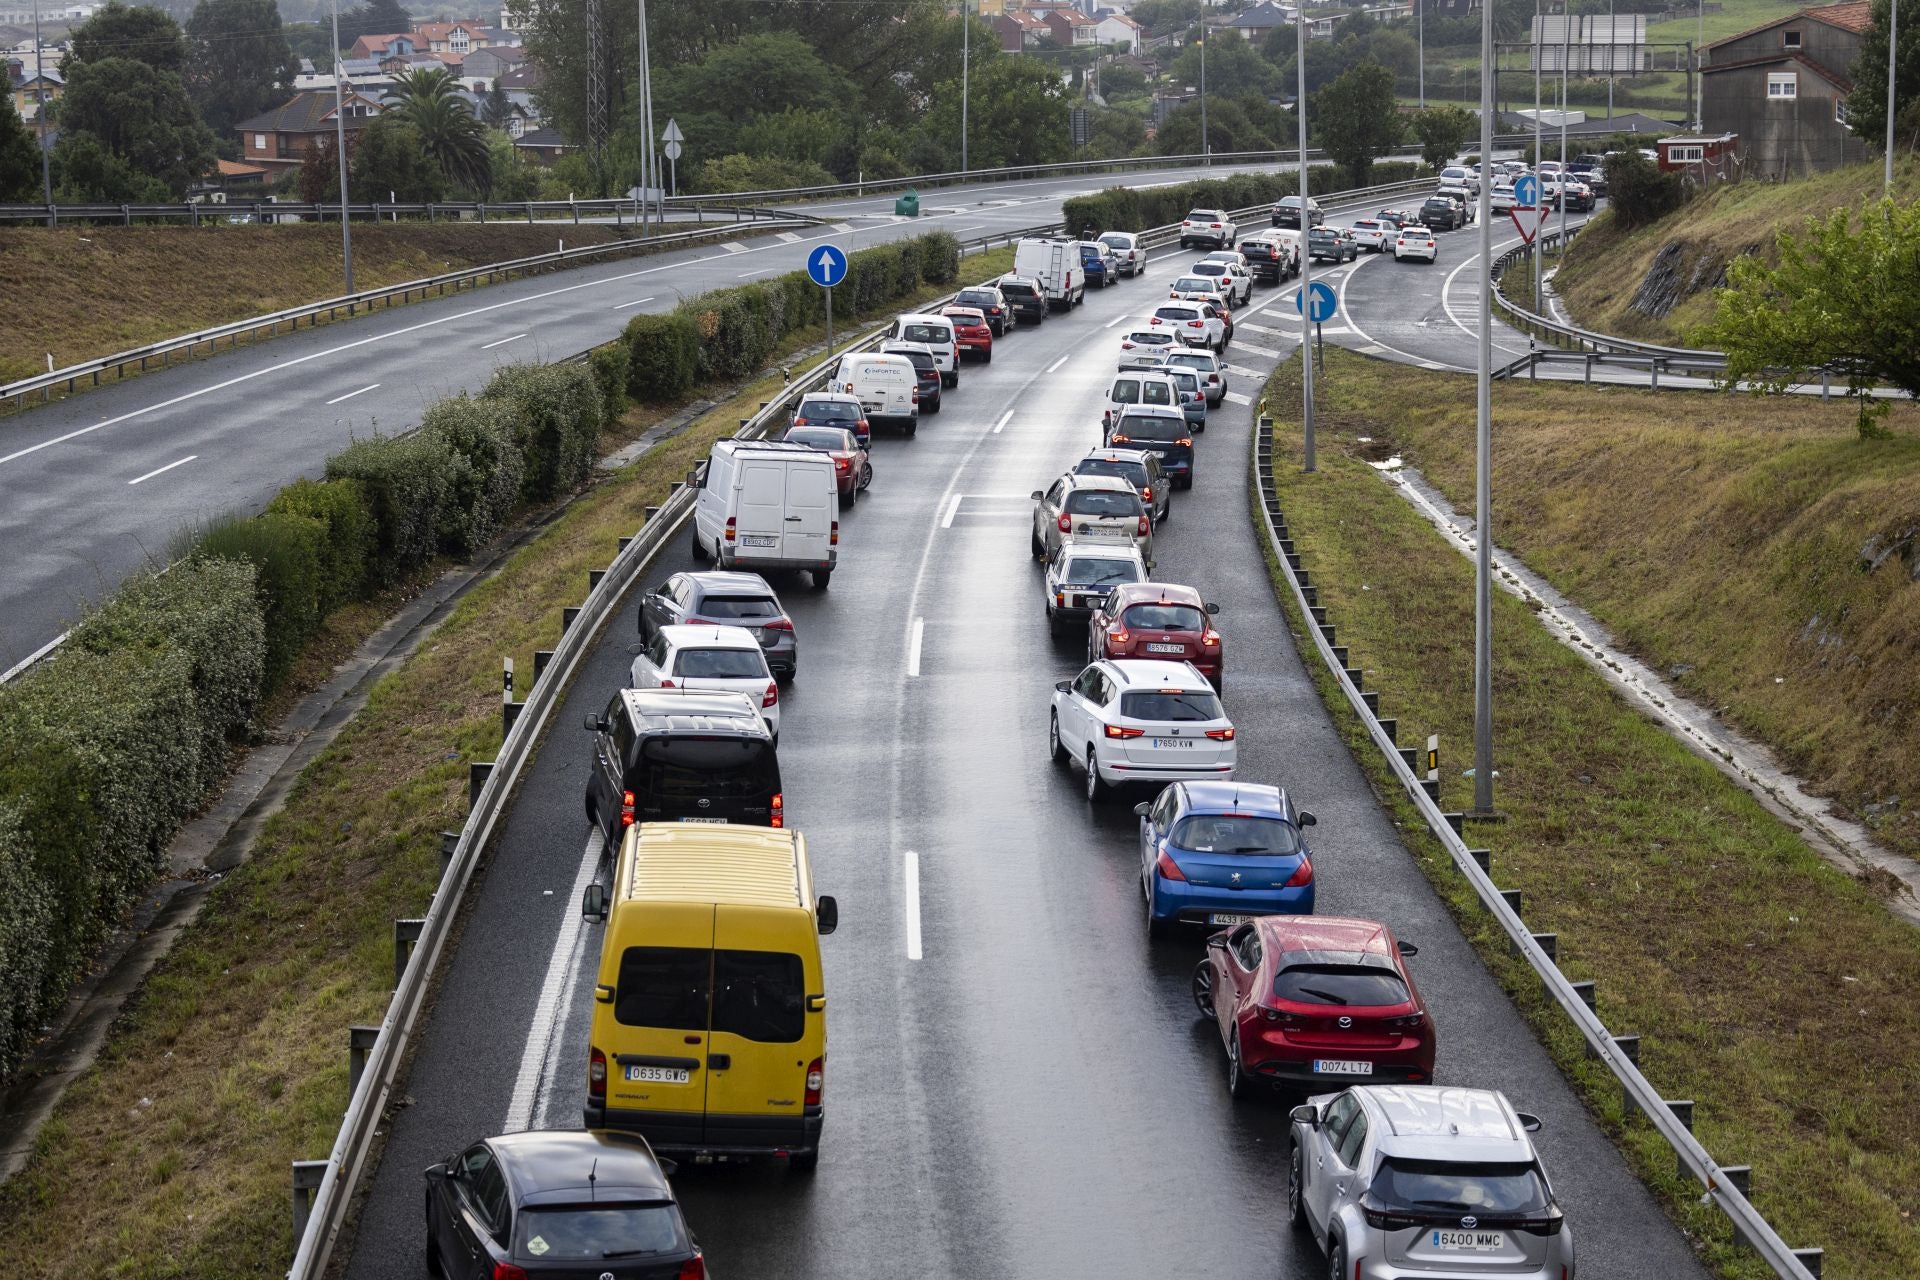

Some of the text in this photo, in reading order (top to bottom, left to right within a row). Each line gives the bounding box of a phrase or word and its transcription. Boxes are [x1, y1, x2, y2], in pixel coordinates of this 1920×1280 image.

[1216, 914, 1237, 923] 4433
[1321, 1061, 1370, 1073] 0074 LTZ
[633, 1067, 687, 1081] 0635 GWG
[1441, 1233, 1500, 1246] 6400 MMC
